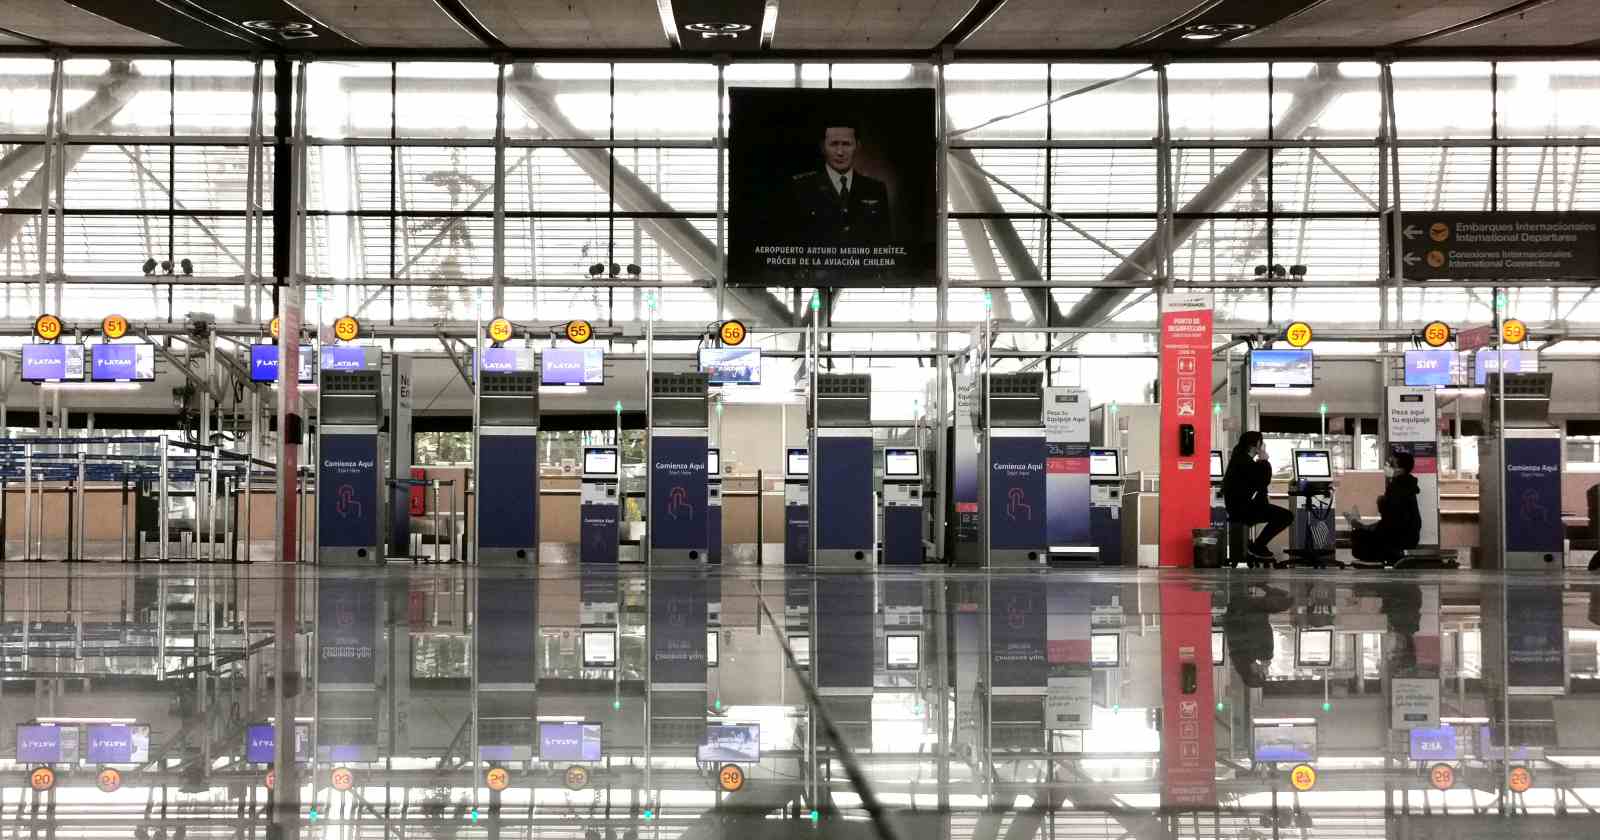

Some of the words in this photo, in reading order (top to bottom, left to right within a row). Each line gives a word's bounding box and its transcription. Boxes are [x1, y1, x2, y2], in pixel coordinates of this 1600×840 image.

[1456, 222, 1513, 233] Embarques
[1515, 221, 1597, 231] Internacionales
[1456, 233, 1518, 241] International
[1521, 233, 1577, 243] Departures
[755, 246, 804, 254] AEROPUERTO
[840, 247, 870, 255] MERINO
[1449, 250, 1501, 258] Conexiones
[766, 255, 797, 265] PRÓCER
[800, 257, 808, 265] DE
[824, 256, 860, 266] AVIACIÓN
[863, 258, 896, 266] CHILENA
[1449, 260, 1503, 268] International
[40, 321, 57, 333] 50
[108, 320, 122, 331] 51
[338, 323, 354, 334] 53
[493, 324, 508, 335] 54
[570, 326, 586, 337] 55
[725, 327, 740, 339] 56
[1292, 329, 1307, 340] 57
[1428, 328, 1445, 340] 58
[1504, 326, 1520, 337] 59
[1391, 408, 1408, 416] Pesa
[1410, 408, 1424, 417] aquí
[1401, 416, 1430, 425] equipaje
[324, 459, 357, 467] Comienza
[358, 459, 374, 468] Aquí
[655, 461, 688, 470] Comienza
[689, 461, 705, 471] Aquí
[1027, 463, 1043, 472] Aquí
[1507, 464, 1541, 472] Comienza
[1541, 463, 1558, 473] Aquí
